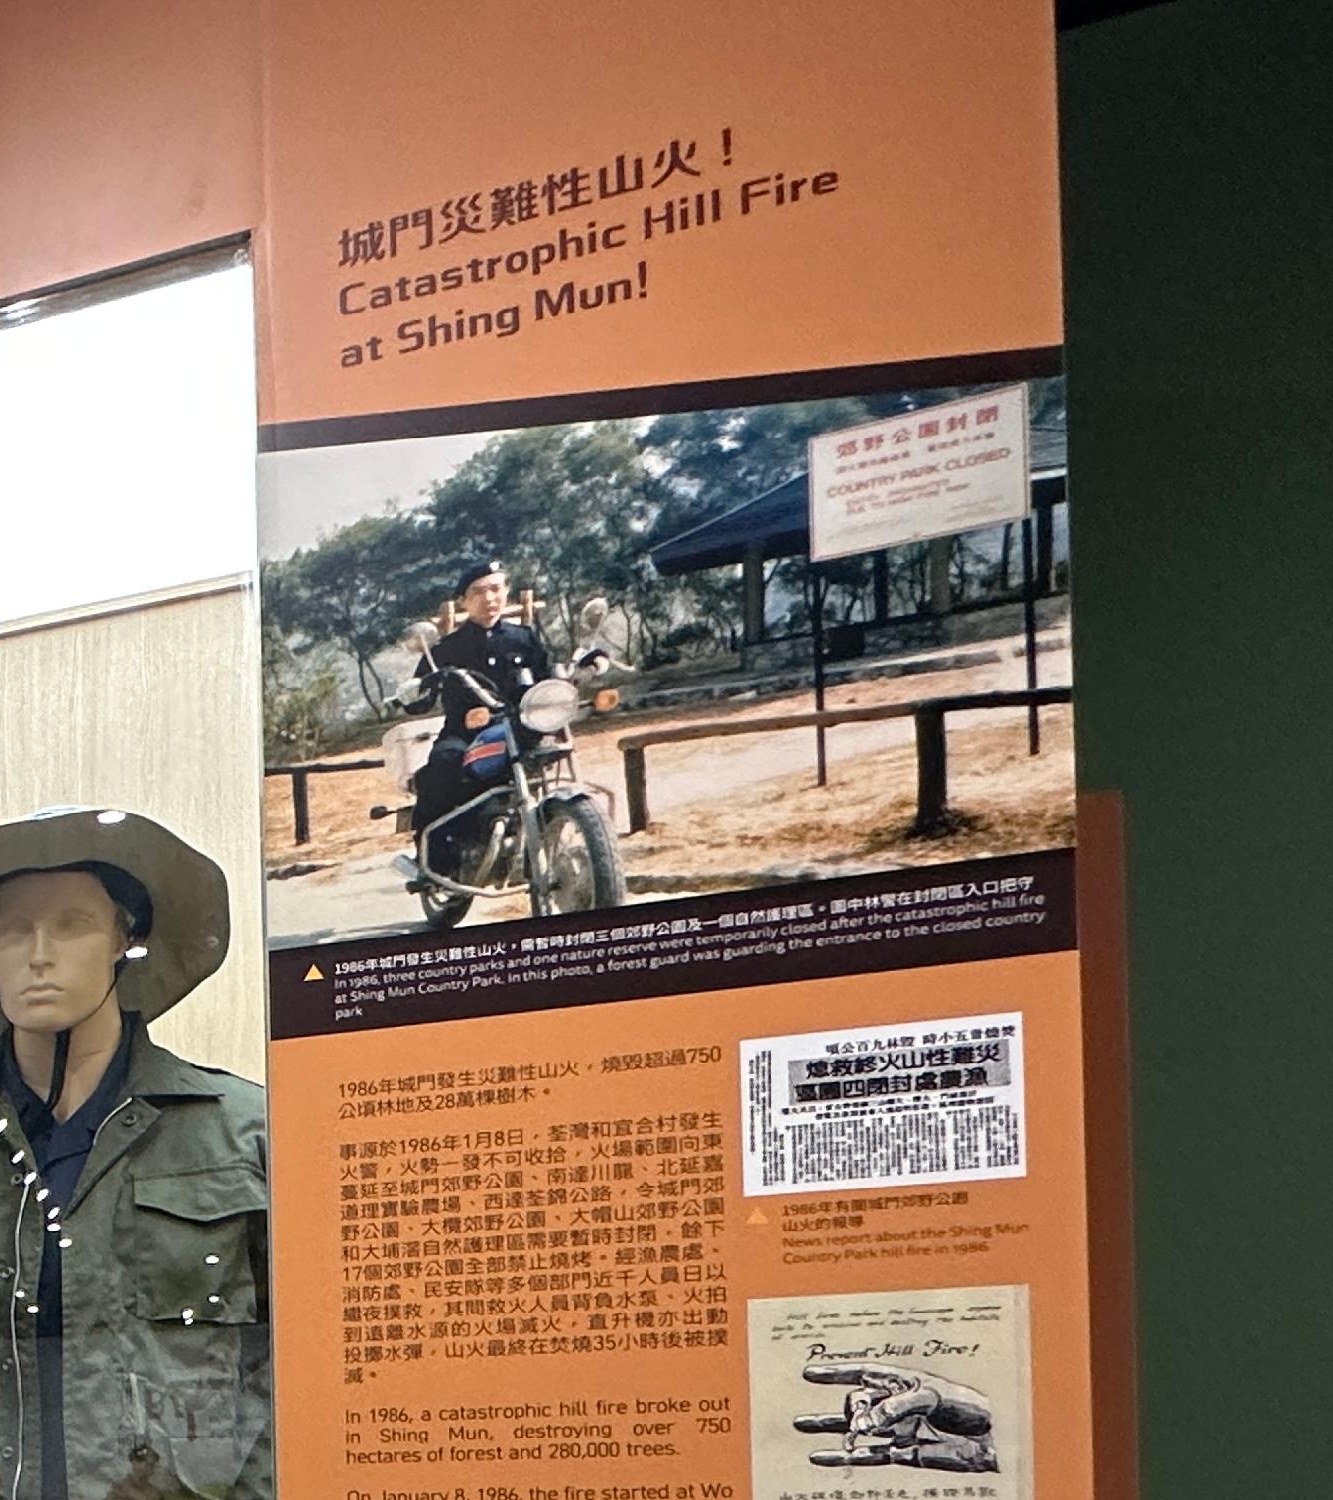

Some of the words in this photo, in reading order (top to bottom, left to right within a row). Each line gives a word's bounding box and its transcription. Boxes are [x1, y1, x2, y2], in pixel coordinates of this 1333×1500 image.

[340, 220, 625, 314] Catastrophic
[644, 192, 720, 239] Hill
[741, 172, 837, 214] Fire
[341, 336, 382, 367] at
[397, 305, 519, 353] Shing
[535, 260, 646, 320] Mun!
[334, 979, 346, 988] In
[383, 971, 415, 983] three
[418, 965, 467, 978] country
[469, 959, 504, 974] parks
[507, 954, 530, 968] and
[533, 953, 558, 964] one
[560, 948, 605, 960] nature
[607, 941, 656, 955] reserve
[659, 938, 693, 948] were
[696, 926, 777, 944] temporarily
[780, 919, 826, 935] closed
[830, 917, 863, 929] after
[867, 913, 892, 924] the
[895, 902, 987, 921] catastrophic
[992, 896, 1015, 908] hill
[1019, 895, 1044, 904] fire
[334, 994, 347, 1003] at
[350, 990, 385, 1001] Shing
[388, 986, 415, 996] Mun
[417, 981, 469, 993] Country
[522, 969, 547, 981] this
[596, 963, 604, 972] a
[607, 958, 646, 970] forest
[649, 951, 689, 969] guard
[693, 949, 720, 960] was
[723, 941, 785, 960] guarding
[788, 938, 812, 949] the
[816, 931, 881, 946] entrance
[885, 929, 900, 938] to
[903, 925, 929, 936] the
[933, 917, 981, 932] closed
[985, 912, 1044, 926] country
[335, 1006, 362, 1020] park
[345, 1409, 360, 1423] In
[421, 1410, 431, 1421] a
[439, 1402, 551, 1420] catastrophic
[559, 1401, 587, 1416] hill
[596, 1400, 627, 1414] fire
[636, 1398, 691, 1413] broke
[699, 1397, 729, 1411] out
[346, 1431, 360, 1443] in
[379, 1428, 428, 1443] Shing
[513, 1422, 611, 1438] destroying
[633, 1423, 674, 1435] over
[696, 1417, 731, 1433] 750
[346, 1449, 421, 1464] hectares
[427, 1446, 443, 1462] of
[450, 1446, 502, 1461] forest
[508, 1443, 541, 1459] and
[548, 1441, 619, 1459] 280,000
[529, 1486, 558, 1500] the
[564, 1486, 595, 1500] fire
[601, 1484, 669, 1500] started
[675, 1484, 694, 1499] at
[700, 1483, 733, 1498] Wo
